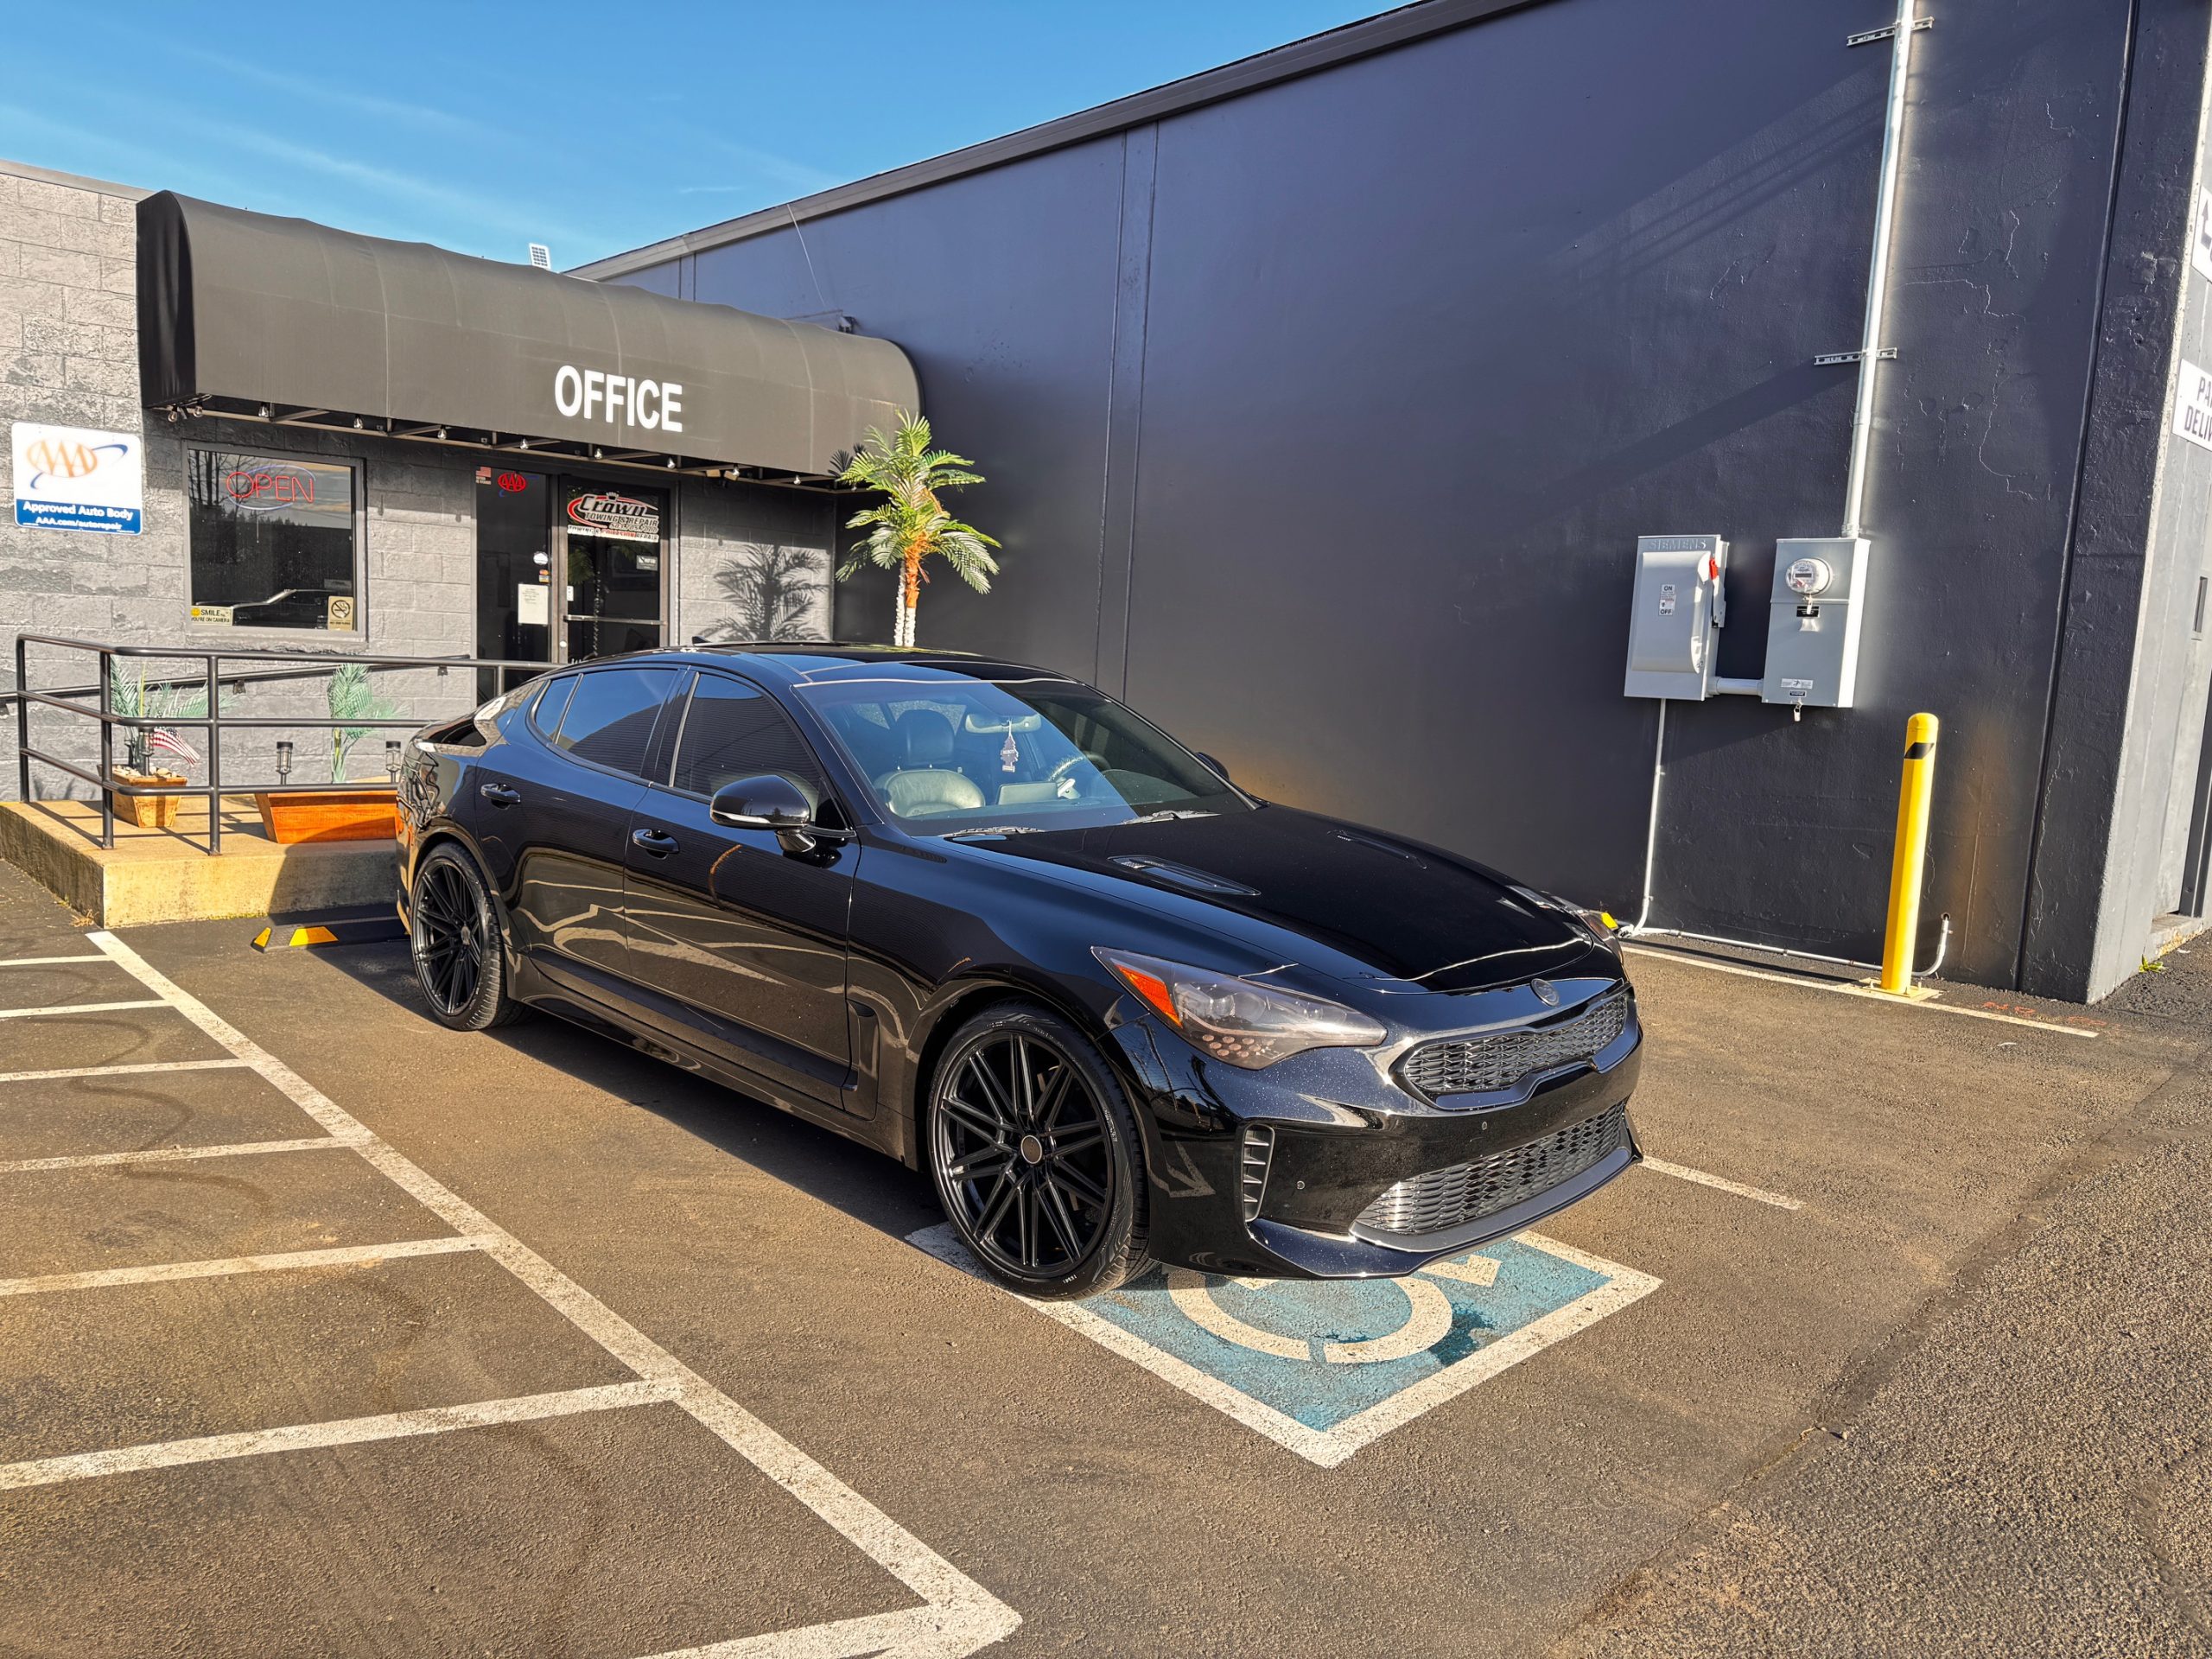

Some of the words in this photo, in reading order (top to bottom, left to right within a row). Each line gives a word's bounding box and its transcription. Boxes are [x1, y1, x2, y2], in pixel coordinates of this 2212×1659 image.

[555, 365, 683, 433] OFFICE
[30, 438, 95, 478] AAA
[226, 471, 315, 503] OPEN
[499, 472, 524, 492] AAA
[22, 501, 76, 515] Approved
[79, 505, 105, 517] Auto
[106, 507, 134, 521] Body
[578, 495, 650, 516] Crown
[585, 512, 619, 523] TOWING
[627, 517, 658, 527] REPAIR
[1649, 538, 1707, 550] SIEMENS
[200, 608, 220, 617] SMILE
